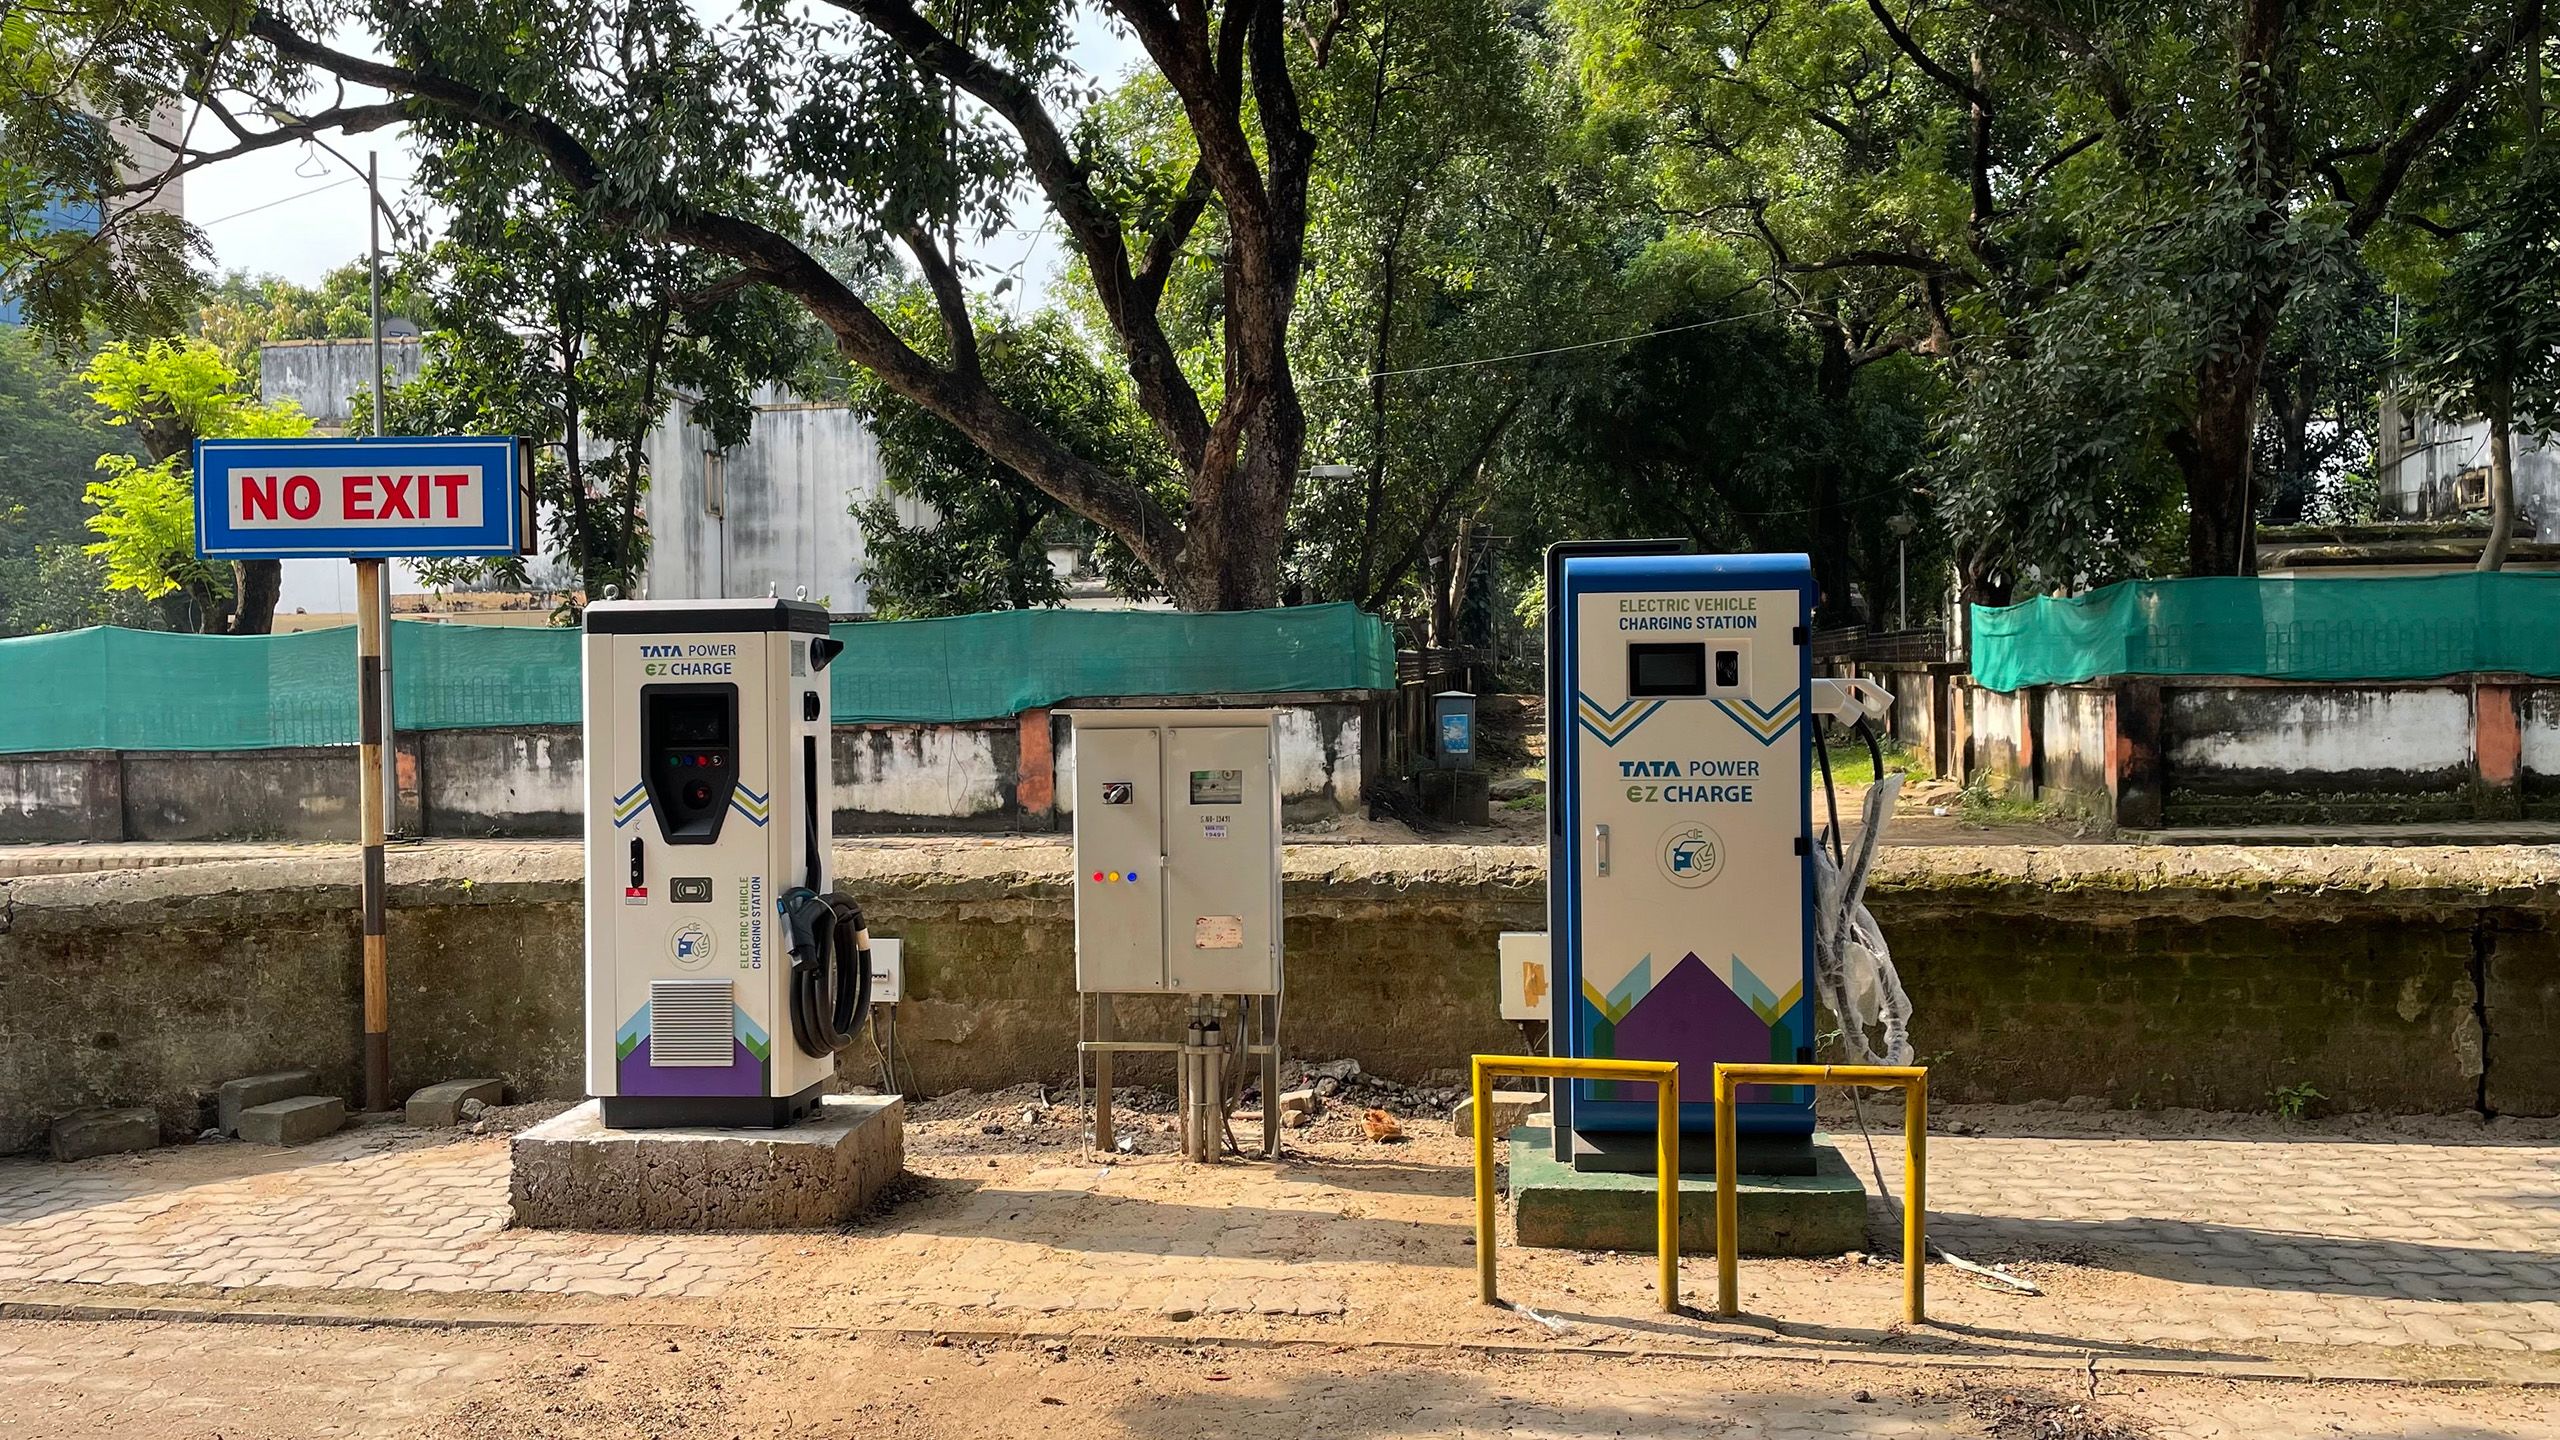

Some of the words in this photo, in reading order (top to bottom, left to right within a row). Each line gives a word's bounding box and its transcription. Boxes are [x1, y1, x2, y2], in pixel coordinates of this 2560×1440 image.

[242, 475, 320, 521] NO
[343, 474, 468, 520] EXIT
[1620, 599, 1690, 612] ELECTRIC
[1695, 597, 1757, 611] VEHICLE
[1619, 617, 1693, 630] CHARGING
[1696, 615, 1757, 630] STATION
[640, 646, 682, 657] TATA
[689, 644, 736, 656] POWER
[645, 664, 667, 676] EZ
[671, 663, 732, 675] CHARGE
[1619, 761, 1681, 777] TATA
[1690, 761, 1760, 777] POWER
[1626, 786, 1658, 802] EZ
[1664, 786, 1753, 802] CHARGE
[739, 876, 749, 919] VEHICLE
[751, 876, 761, 918] STATION
[739, 921, 749, 969] ELECTRIC
[751, 919, 761, 969] CHARGING
